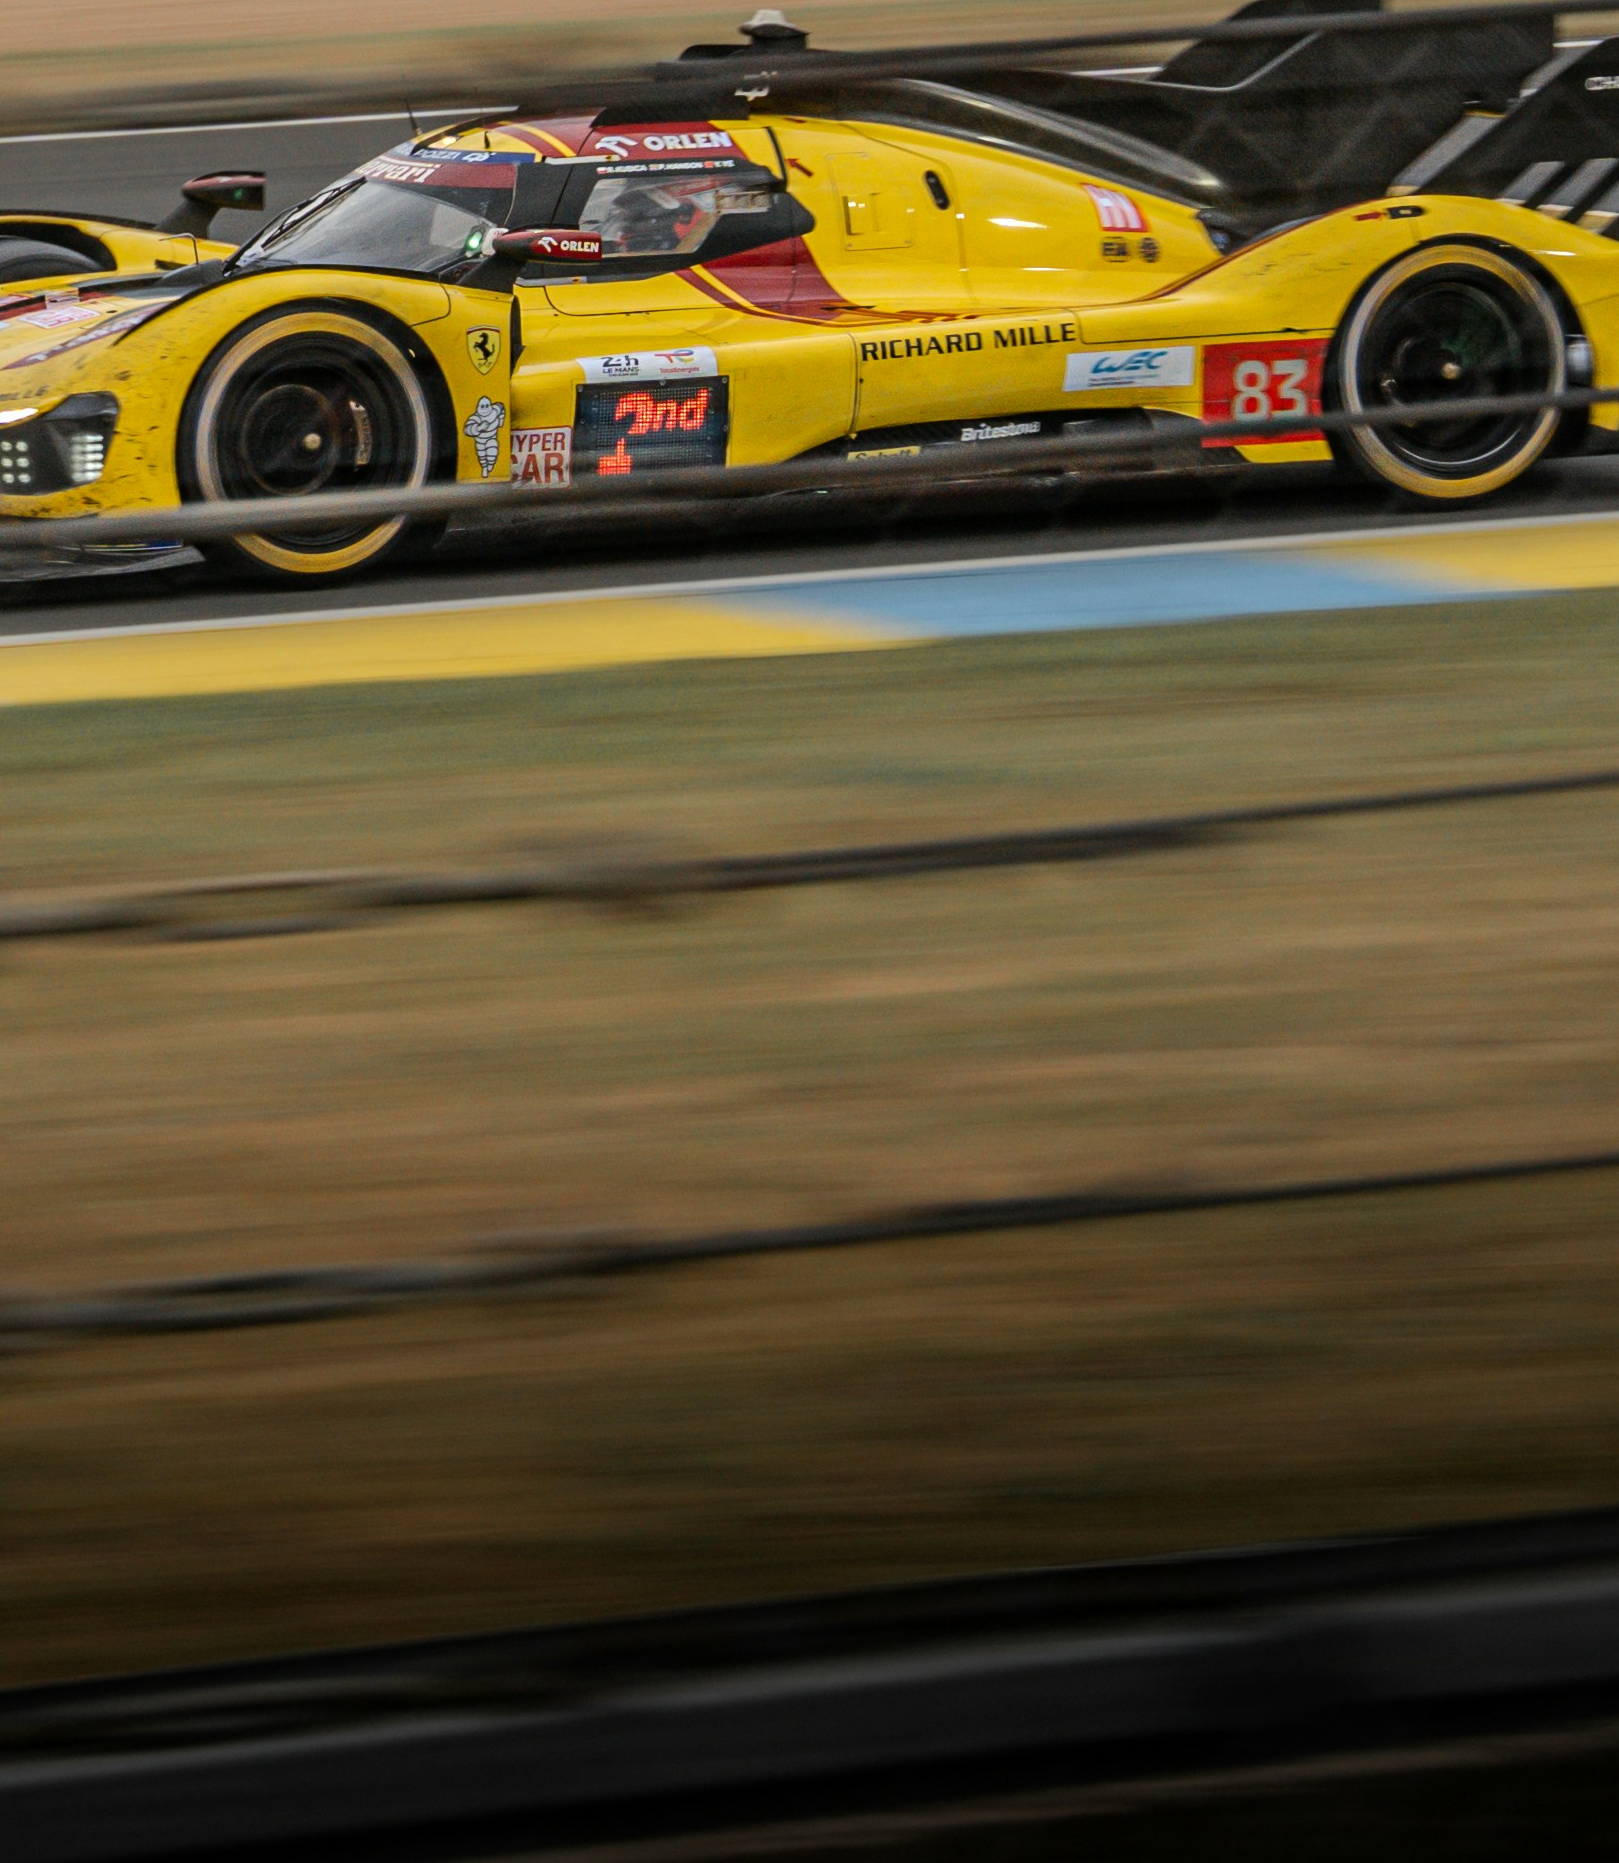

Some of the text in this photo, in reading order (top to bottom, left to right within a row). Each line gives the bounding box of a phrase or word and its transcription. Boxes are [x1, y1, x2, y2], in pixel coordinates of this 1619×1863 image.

[643, 131, 733, 151] ORLEN
[560, 240, 600, 253] ORLEN
[860, 322, 1077, 362] RICHARD MILLE
[1090, 350, 1169, 374] WEC
[1233, 358, 1311, 423] 83
[511, 431, 566, 453] YPER
